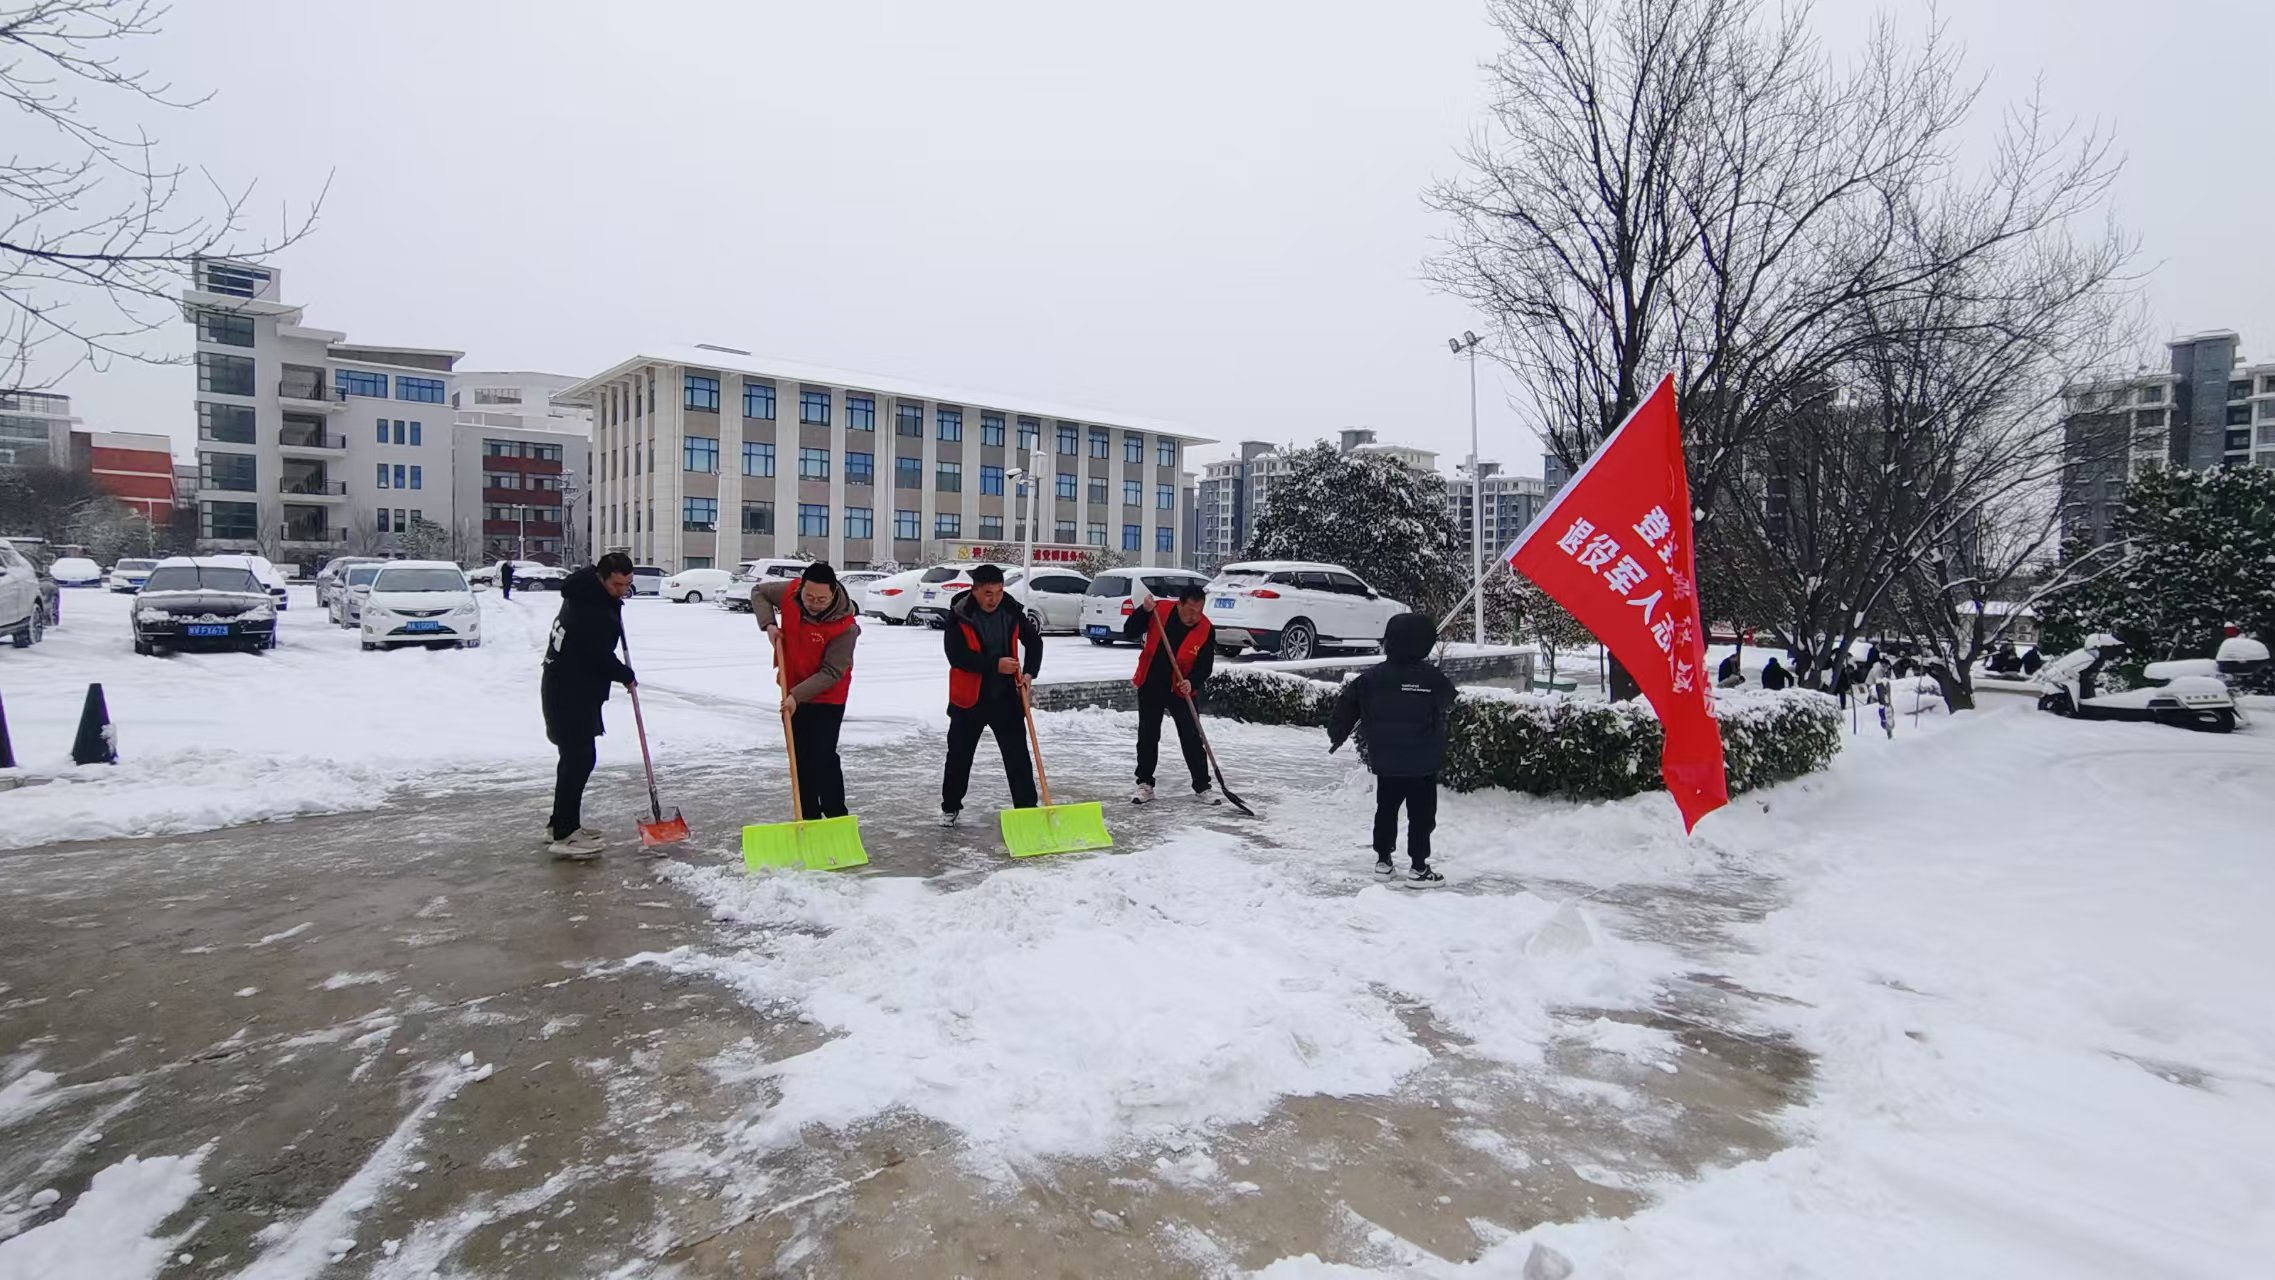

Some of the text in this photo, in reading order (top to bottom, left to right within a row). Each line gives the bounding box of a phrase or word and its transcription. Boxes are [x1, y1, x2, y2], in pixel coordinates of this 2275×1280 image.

[1556, 516, 1676, 664] 退役军人志
